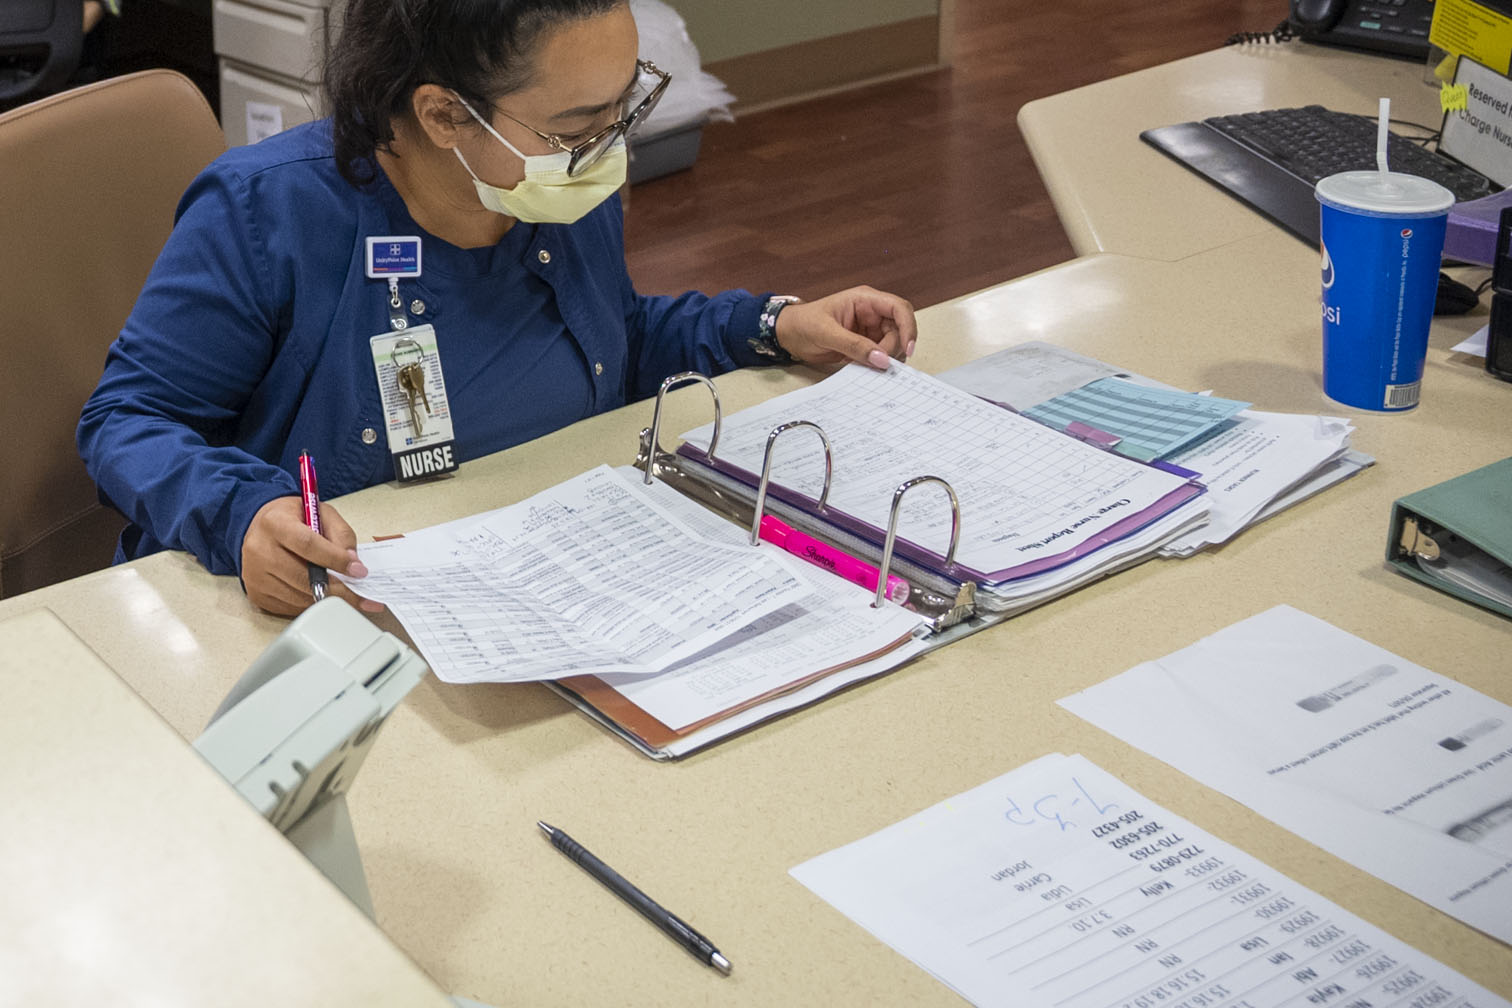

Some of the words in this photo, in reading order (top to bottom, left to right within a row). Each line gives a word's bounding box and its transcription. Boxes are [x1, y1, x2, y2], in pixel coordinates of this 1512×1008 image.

[1468, 82, 1509, 115] Reserved
[1459, 108, 1492, 135] Charge
[399, 444, 455, 479] NURSE
[1096, 497, 1131, 515] Charge
[1070, 514, 1098, 530] Nurse
[1038, 527, 1073, 546] Report
[1091, 810, 1144, 838] 205-4327
[1108, 821, 1164, 850] 205-6302
[1129, 832, 1184, 861] 770-7263
[1150, 844, 1205, 873] 729-0879
[991, 860, 1033, 882] Jordan
[1014, 872, 1053, 893] Carrie
[1139, 879, 1175, 898] Kelly
[1040, 884, 1073, 902] Lidia
[1065, 896, 1094, 912] Lisa
[1111, 923, 1136, 938] RN
[1133, 938, 1160, 954] RN
[1239, 935, 1270, 952] Lisa
[1158, 953, 1183, 968] RN
[1266, 951, 1295, 965] Ian
[1306, 981, 1347, 1006] Kayla
